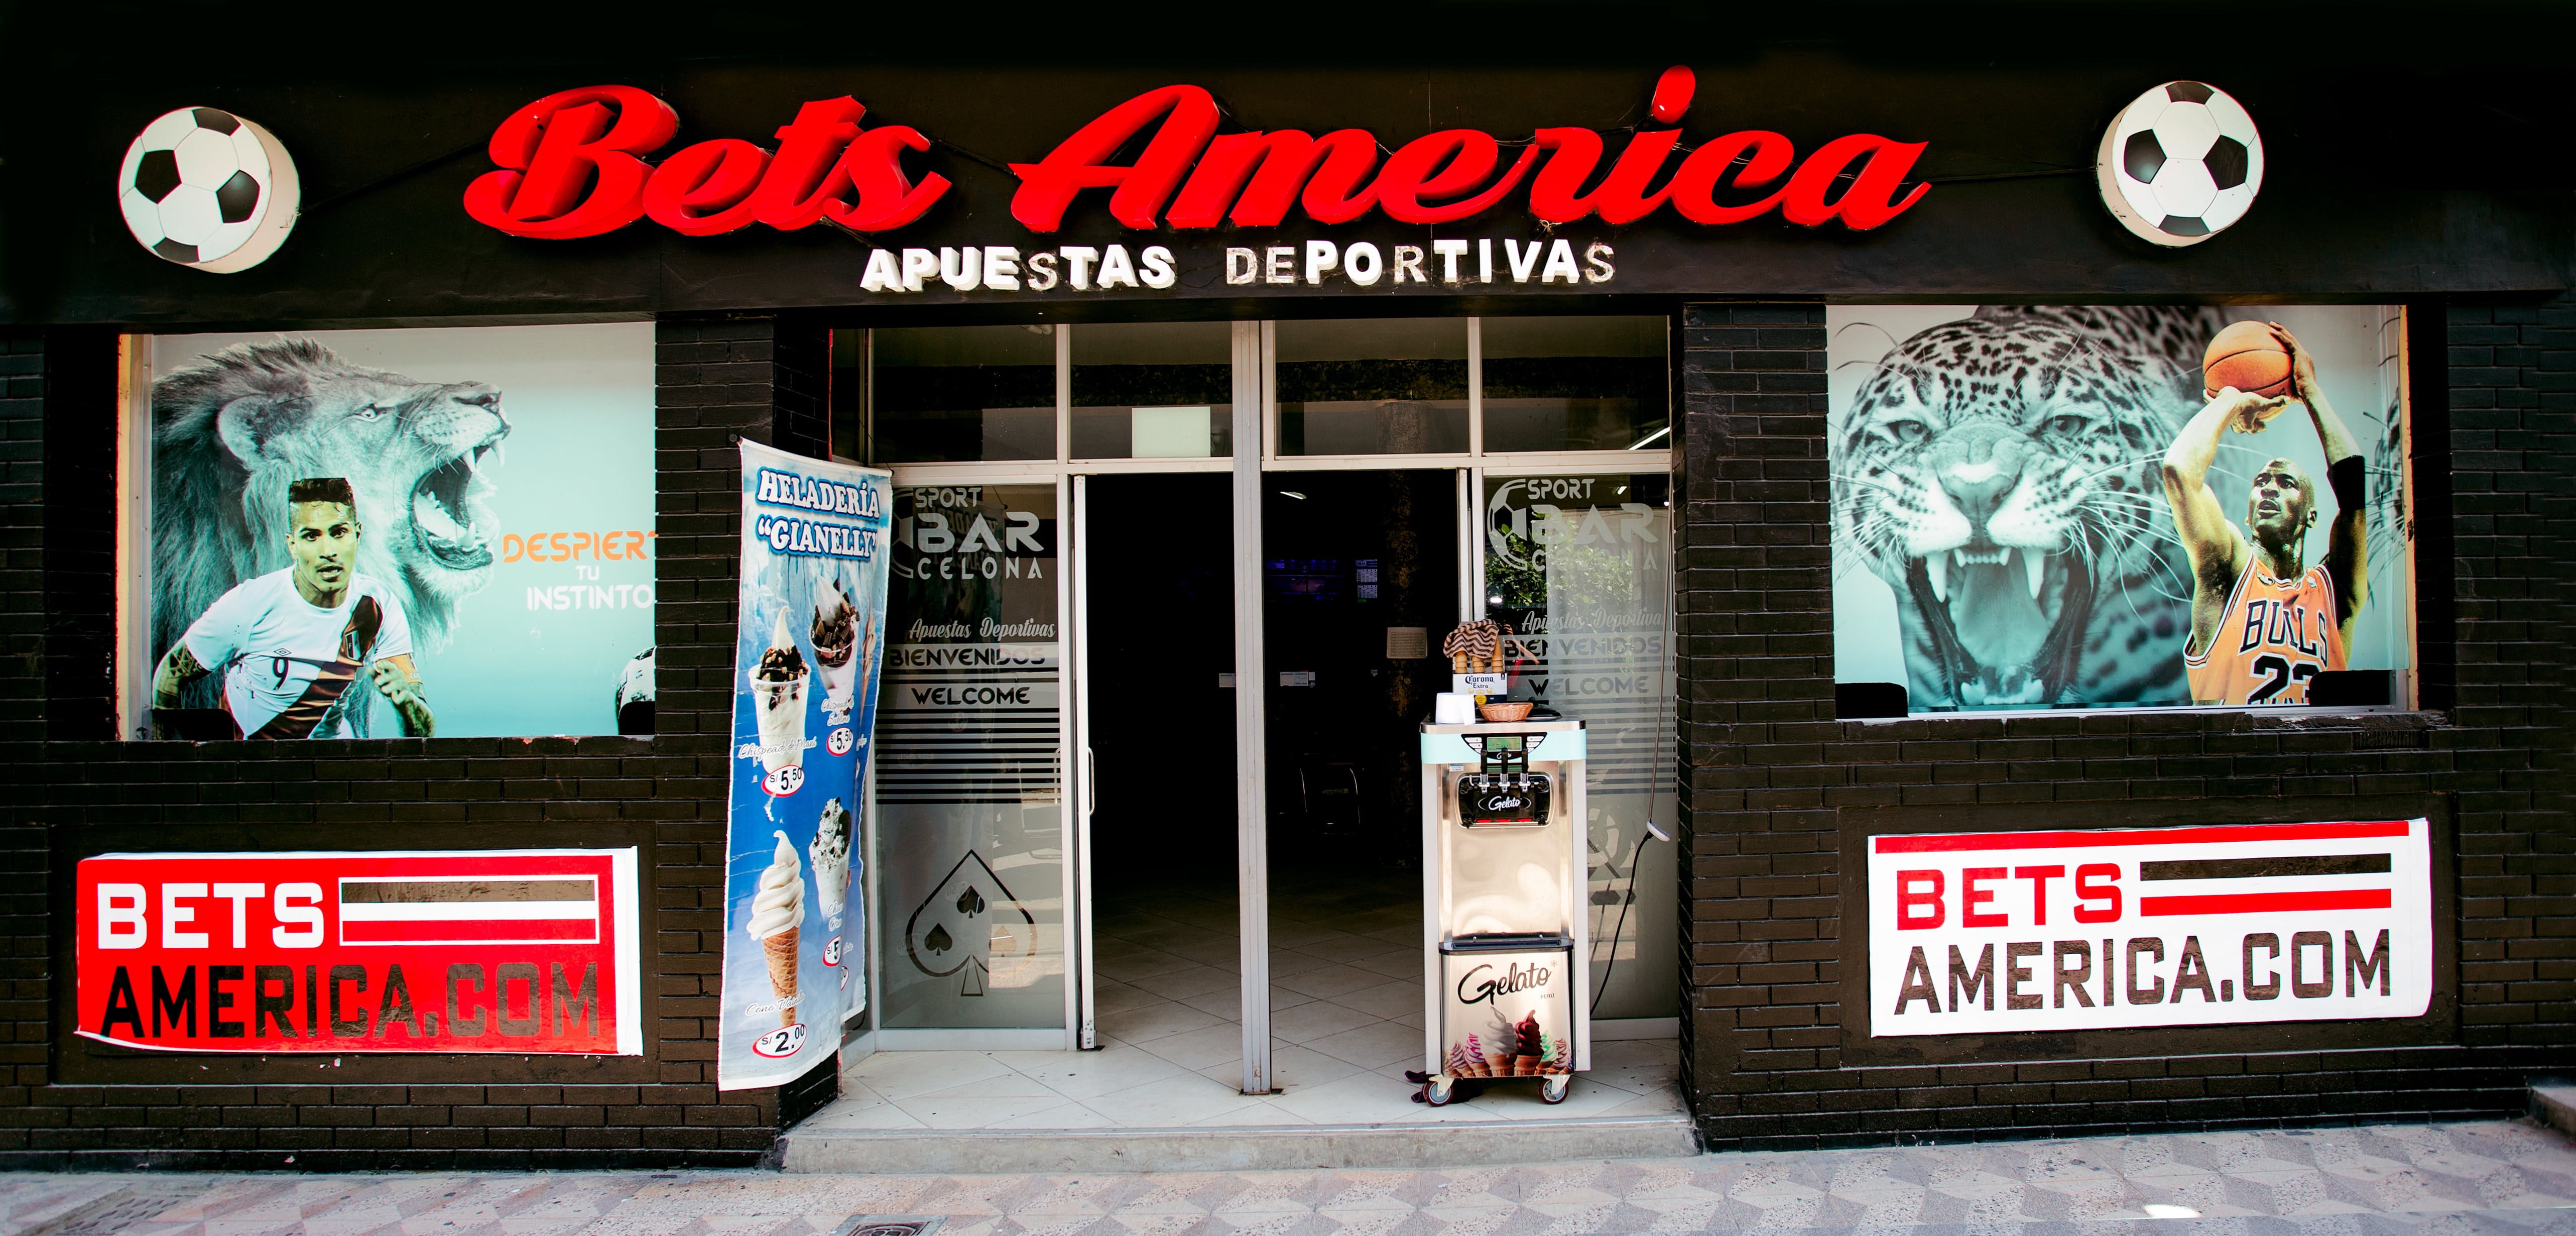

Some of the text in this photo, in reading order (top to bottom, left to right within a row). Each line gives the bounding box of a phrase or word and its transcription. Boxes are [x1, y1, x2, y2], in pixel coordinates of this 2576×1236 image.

[463, 64, 1931, 239] Bets America
[860, 239, 1615, 292] APUESTAS DEPORTIVAS
[758, 469, 880, 518] HELADERÍA
[915, 487, 982, 508] SPORT
[1528, 479, 1595, 500] SPORT
[918, 511, 1044, 552] BAR
[1531, 503, 1659, 544] BAR
[575, 565, 600, 581] TU
[918, 557, 1043, 579] CELONA
[527, 584, 654, 611] INSTINTO
[909, 617, 1056, 642] Apuestas Deportivas
[1522, 611, 1584, 634] Apuestas
[889, 647, 1045, 666] BIENVENIDOS
[1504, 636, 1662, 657] BIENVENIDOS
[273, 657, 289, 691] 9
[1465, 675, 1494, 685] Corona
[1528, 676, 1649, 696] WELCOME
[911, 687, 1030, 705] WELCOME
[1488, 796, 1521, 812] Gelato
[1897, 863, 2122, 931] BETS
[97, 882, 324, 949] BETS
[1457, 963, 1551, 1005] Gelato
[1894, 929, 2390, 1016] AMERICA.COM
[101, 962, 597, 1039] AMERICA.COM
